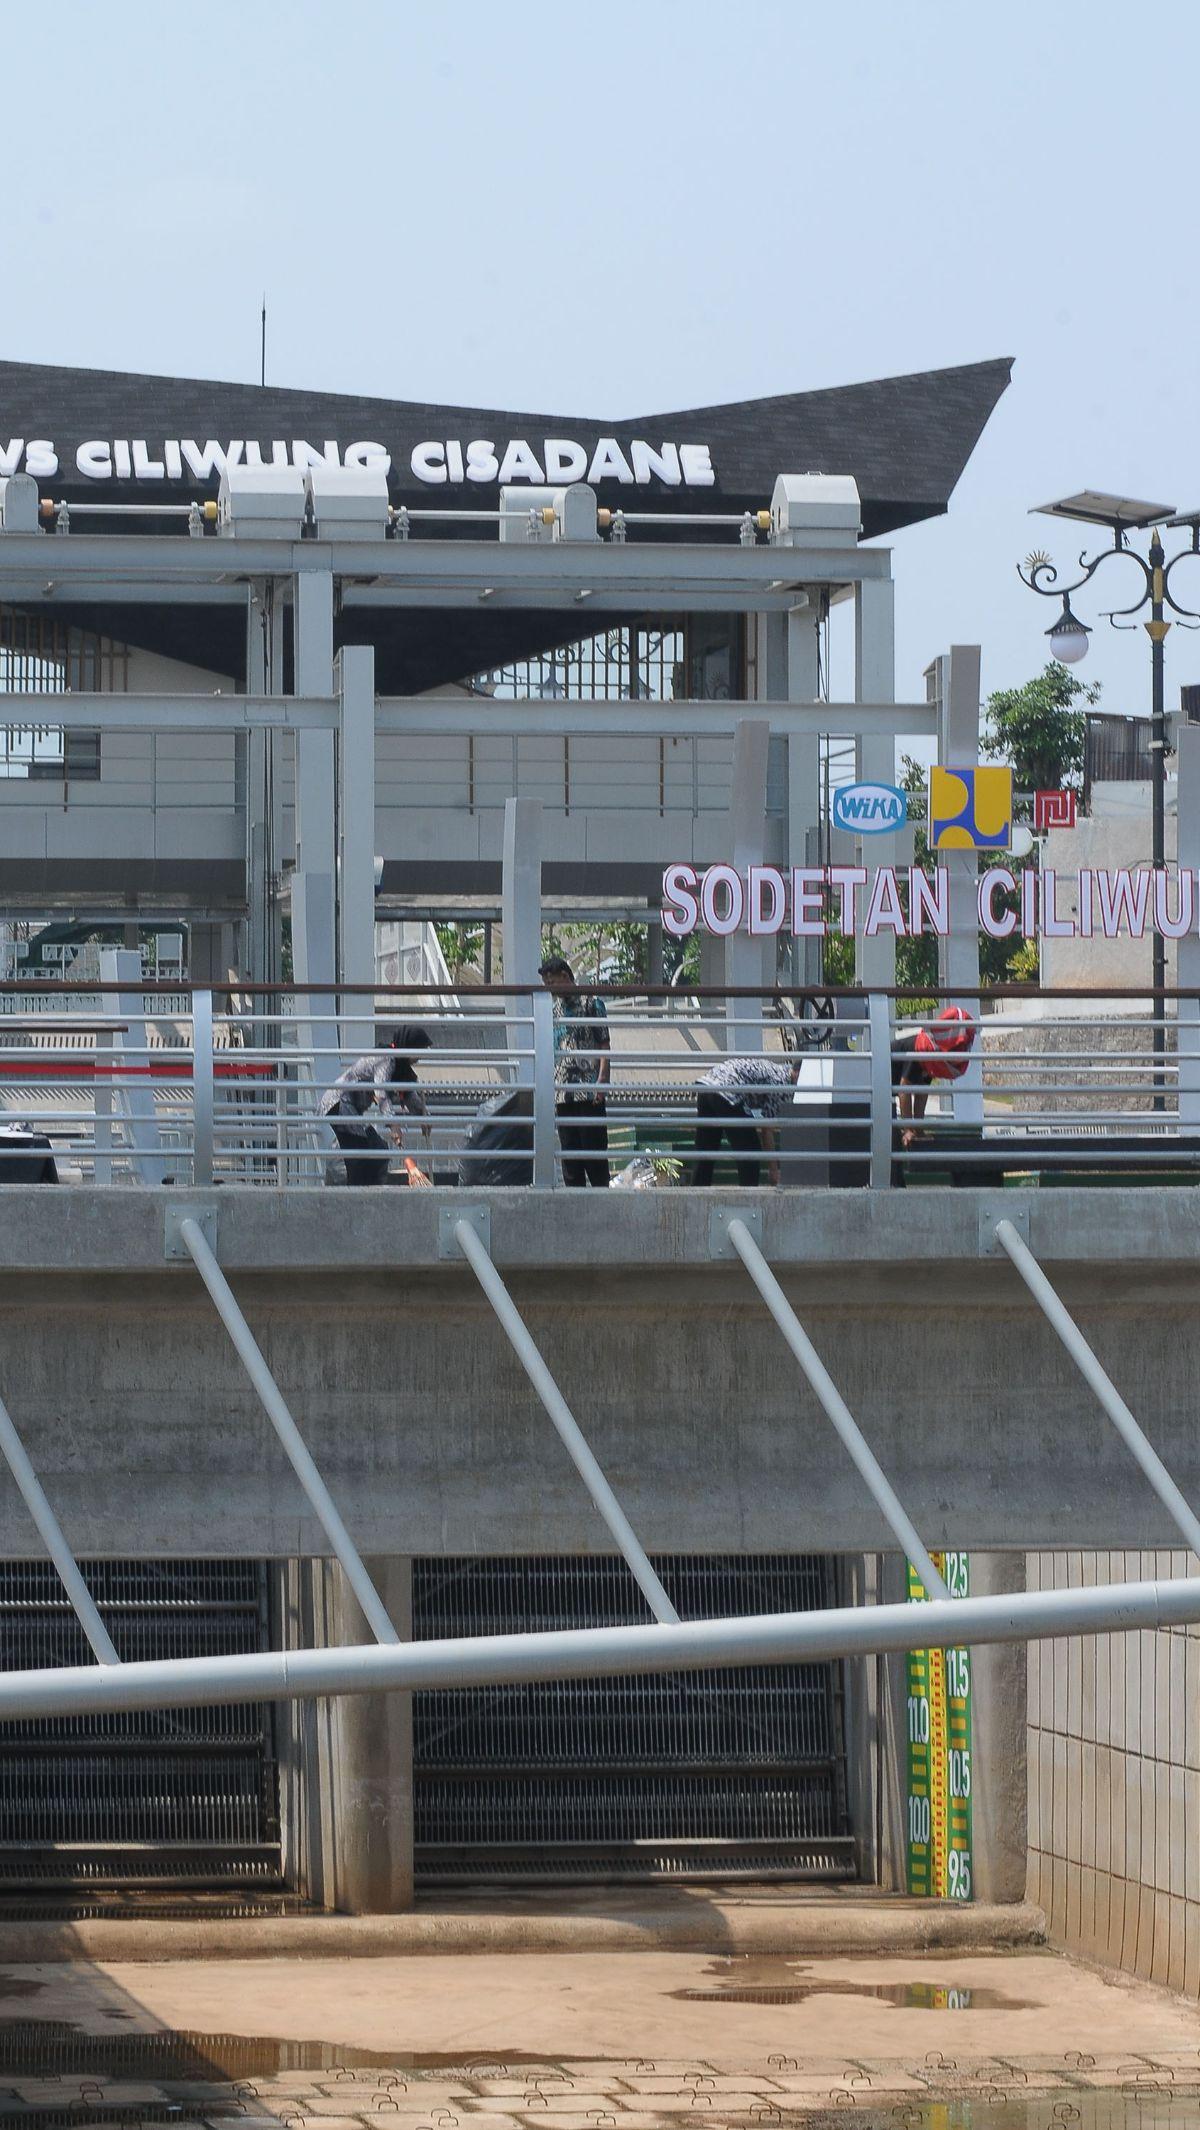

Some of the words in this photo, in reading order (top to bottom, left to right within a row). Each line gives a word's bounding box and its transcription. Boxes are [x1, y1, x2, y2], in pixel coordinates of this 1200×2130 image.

[76, 439, 391, 479] CILIWUNG
[411, 438, 716, 486] CISADANE
[661, 863, 951, 937] SODETAN
[976, 867, 1200, 939] CILIWU
[945, 1552, 969, 1598] 12.5
[946, 1649, 969, 1698] 11.5
[907, 1696, 930, 1744] 11.0
[948, 1749, 971, 1798] 10.5
[908, 1795, 931, 1844] 10.0
[948, 1849, 971, 1899] 9.5
